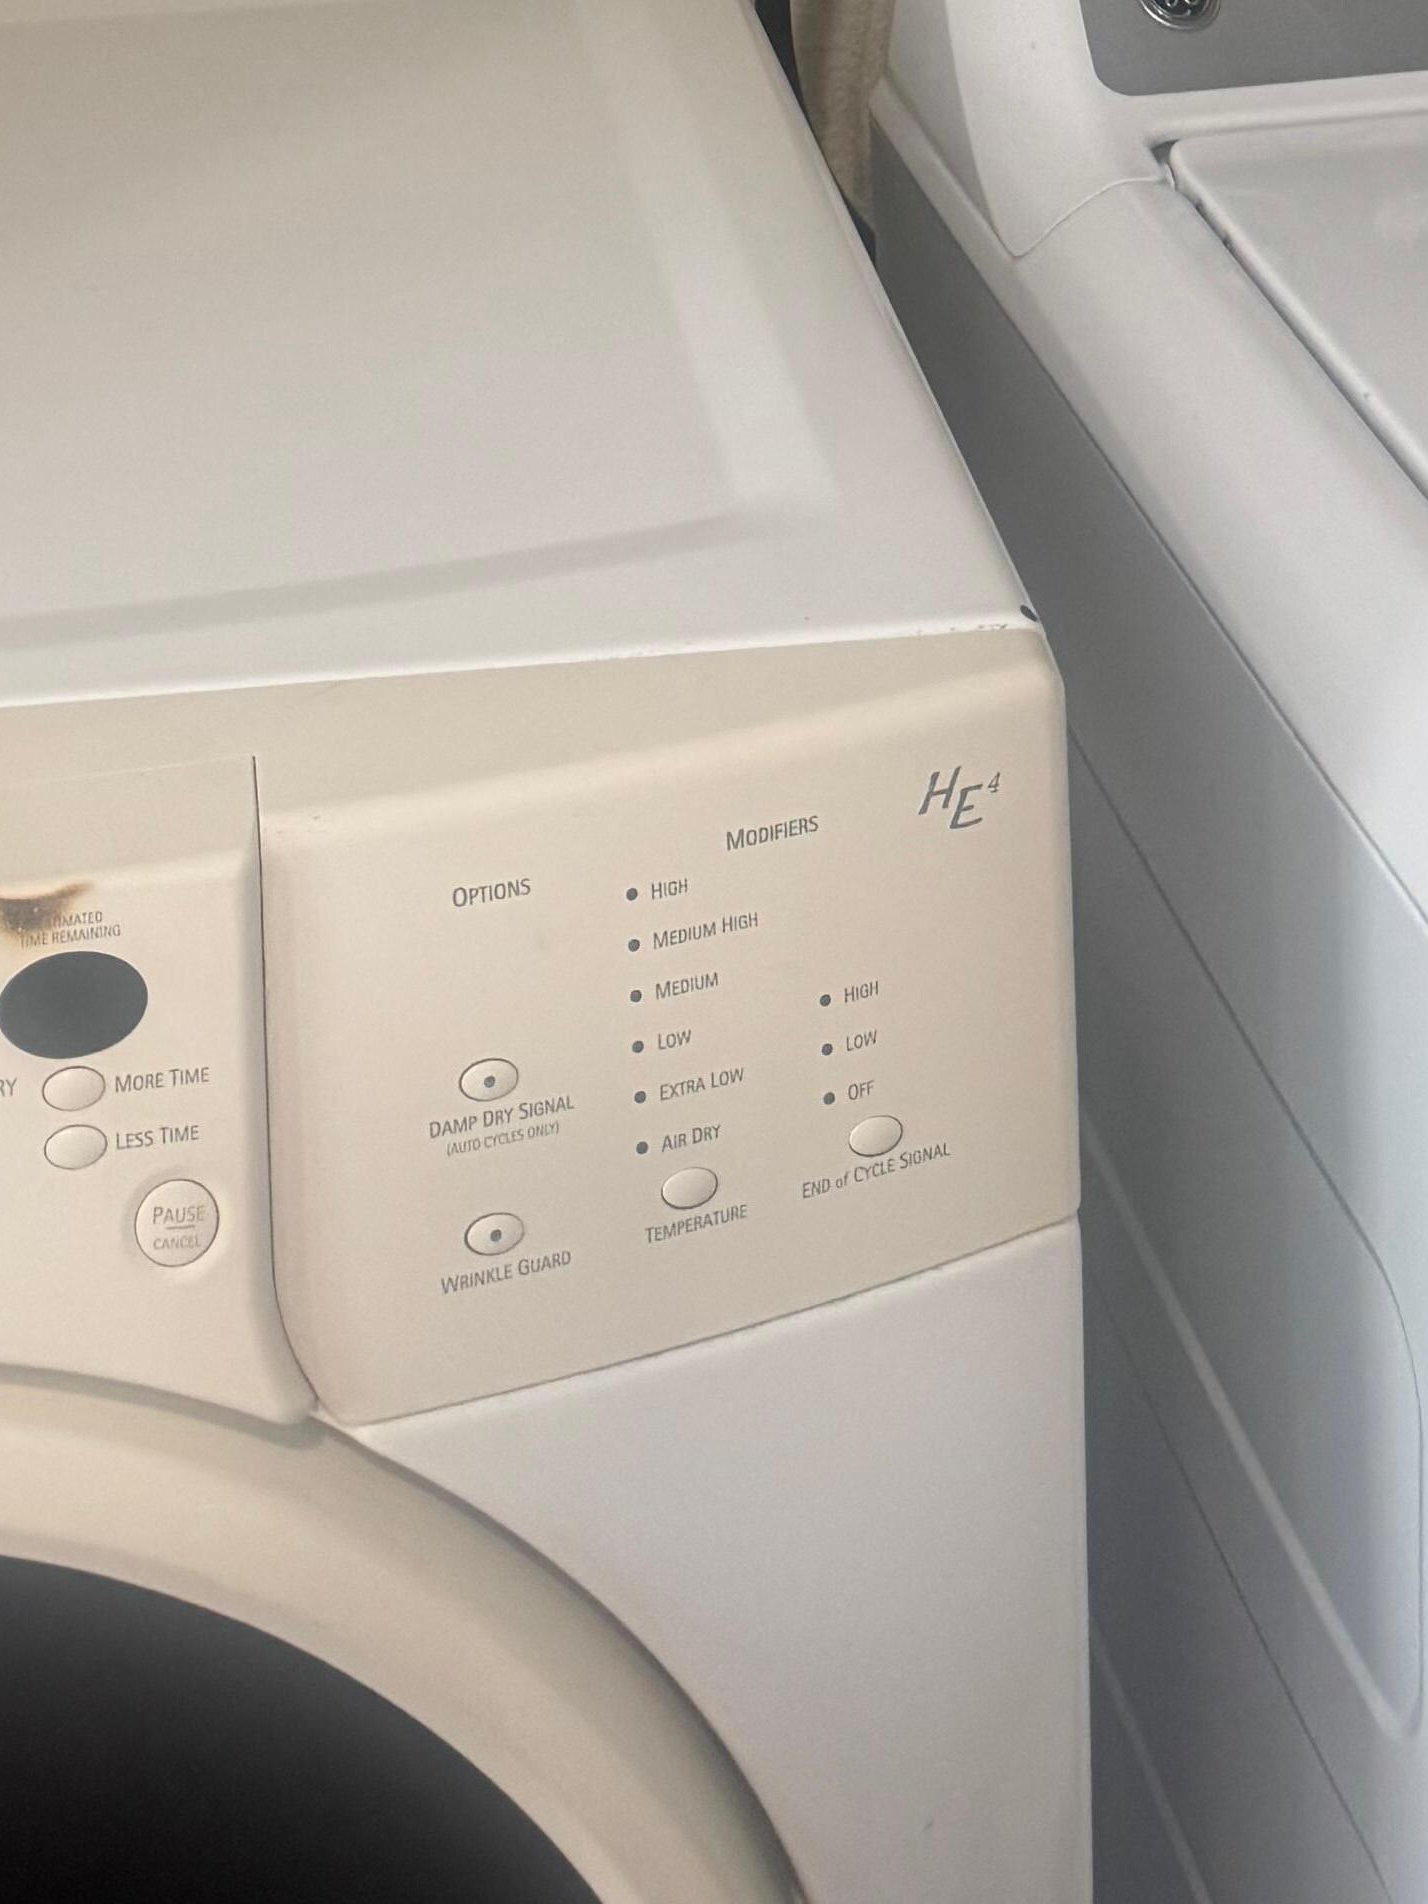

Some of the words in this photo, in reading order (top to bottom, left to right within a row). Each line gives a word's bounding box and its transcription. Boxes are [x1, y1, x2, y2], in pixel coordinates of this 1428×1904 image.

[726, 816, 819, 853] MODIFIERS
[452, 878, 531, 908] OPTIONS
[651, 878, 689, 899] HIGH
[652, 921, 716, 951] MEDIUM
[721, 911, 759, 934] HIGH
[655, 973, 719, 1001] MEDIUM
[844, 981, 880, 1004] HIGH
[657, 1030, 692, 1051] LOW
[846, 1030, 878, 1051] LOW
[115, 1072, 165, 1092] MORE
[170, 1067, 210, 1086] TIME
[659, 1077, 706, 1104] EXTRA
[710, 1068, 745, 1091] LOW
[848, 1081, 875, 1101] OFF
[429, 1113, 478, 1139] DAMP
[482, 1105, 512, 1129] DRY
[517, 1095, 574, 1122] SIGNAL
[116, 1130, 156, 1150] LESS
[160, 1125, 200, 1144] TIME
[662, 1131, 688, 1153] AIR
[691, 1124, 721, 1146] DRY
[801, 1177, 832, 1200] END
[853, 1159, 896, 1186] CYCLE
[899, 1142, 951, 1172] SIGNAL
[153, 1204, 205, 1225] PAUSE
[645, 1204, 748, 1245] TEMPERATURE
[153, 1235, 202, 1251] CANCEL
[441, 1263, 513, 1295] WRINKLE
[517, 1250, 572, 1279] GUARD
